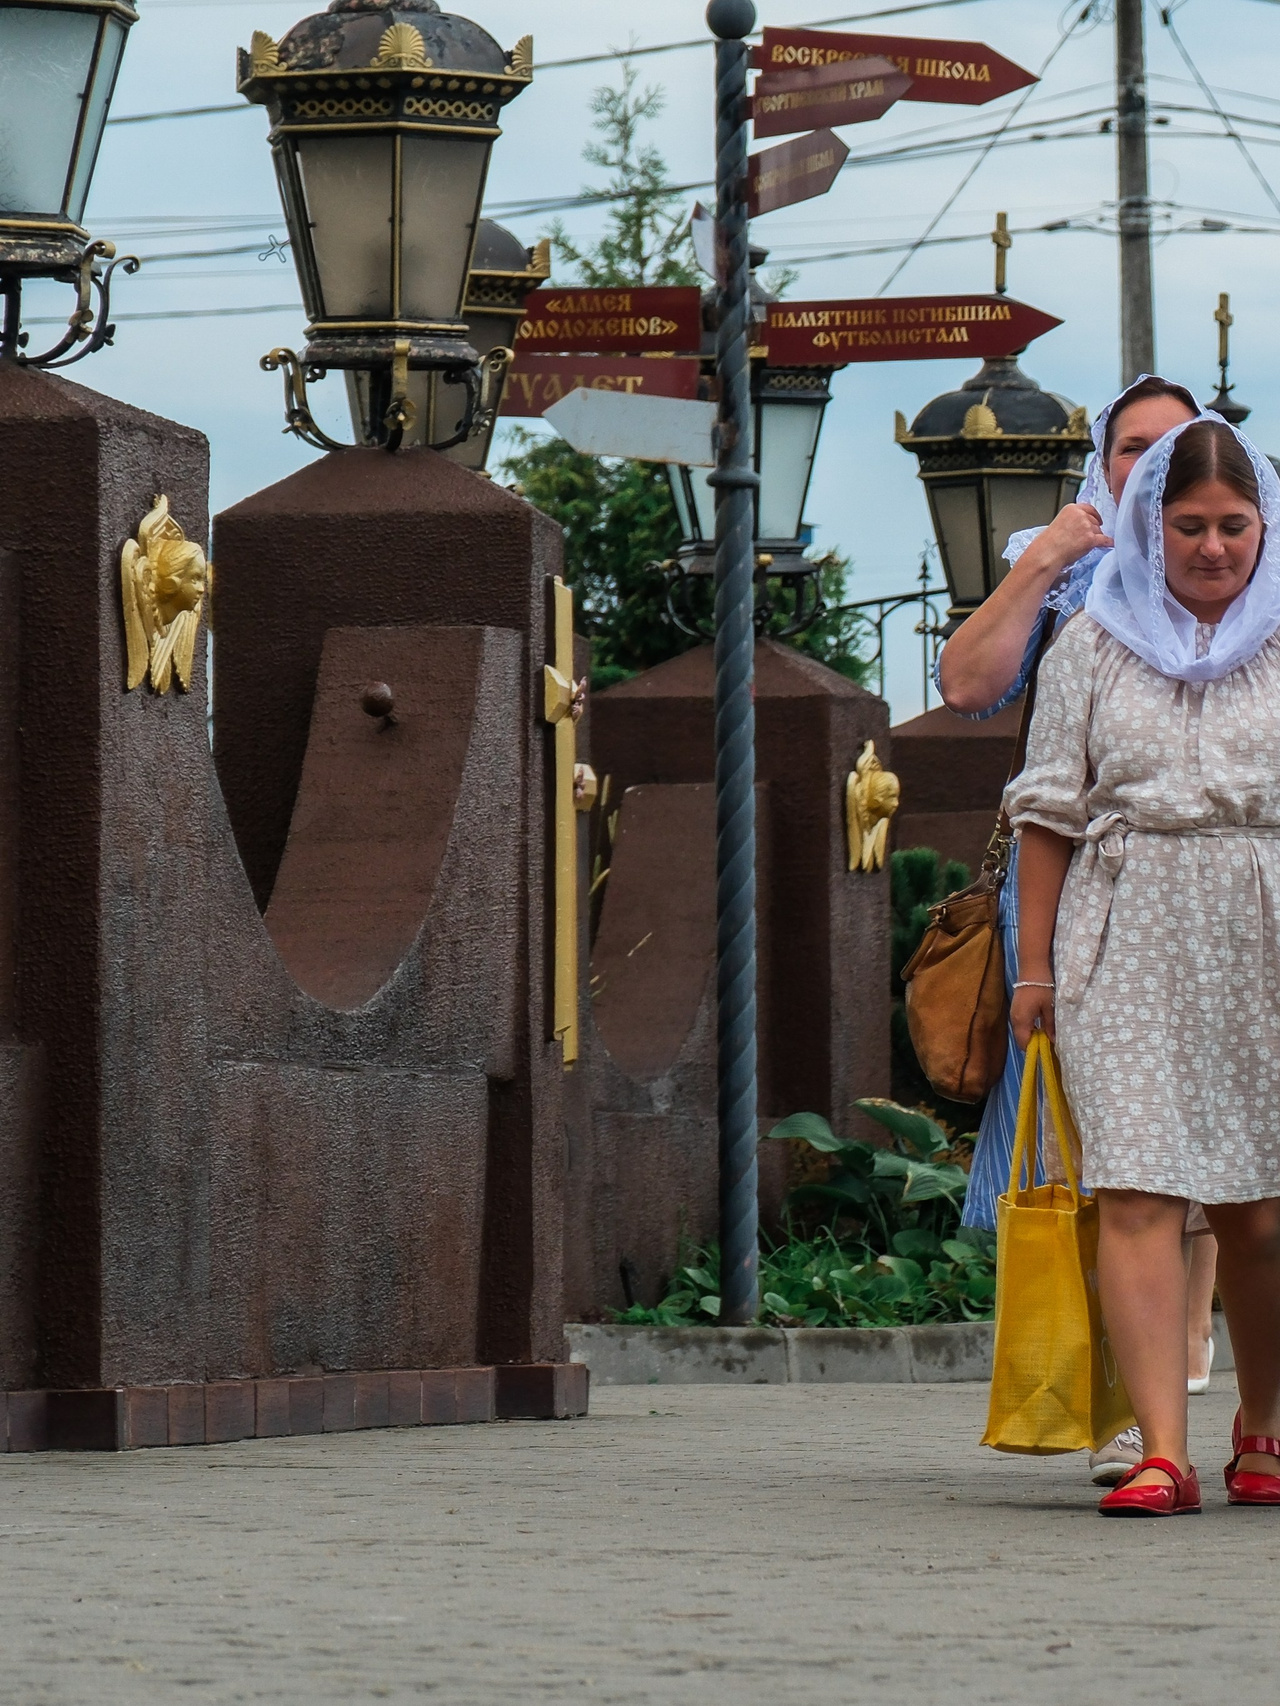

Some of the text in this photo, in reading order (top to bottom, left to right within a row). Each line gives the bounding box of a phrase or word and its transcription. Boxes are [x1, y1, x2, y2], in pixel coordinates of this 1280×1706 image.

[915, 57, 990, 82] ШКОЛА
[545, 292, 631, 314] «АЛЛЕЯ
[514, 315, 679, 340] ОЛОДОЖЕНОВ»
[770, 304, 1012, 328] ПАМЯТНИК ПОГИБШИМ
[811, 326, 970, 351] ФУТБОЛИСТАМ
